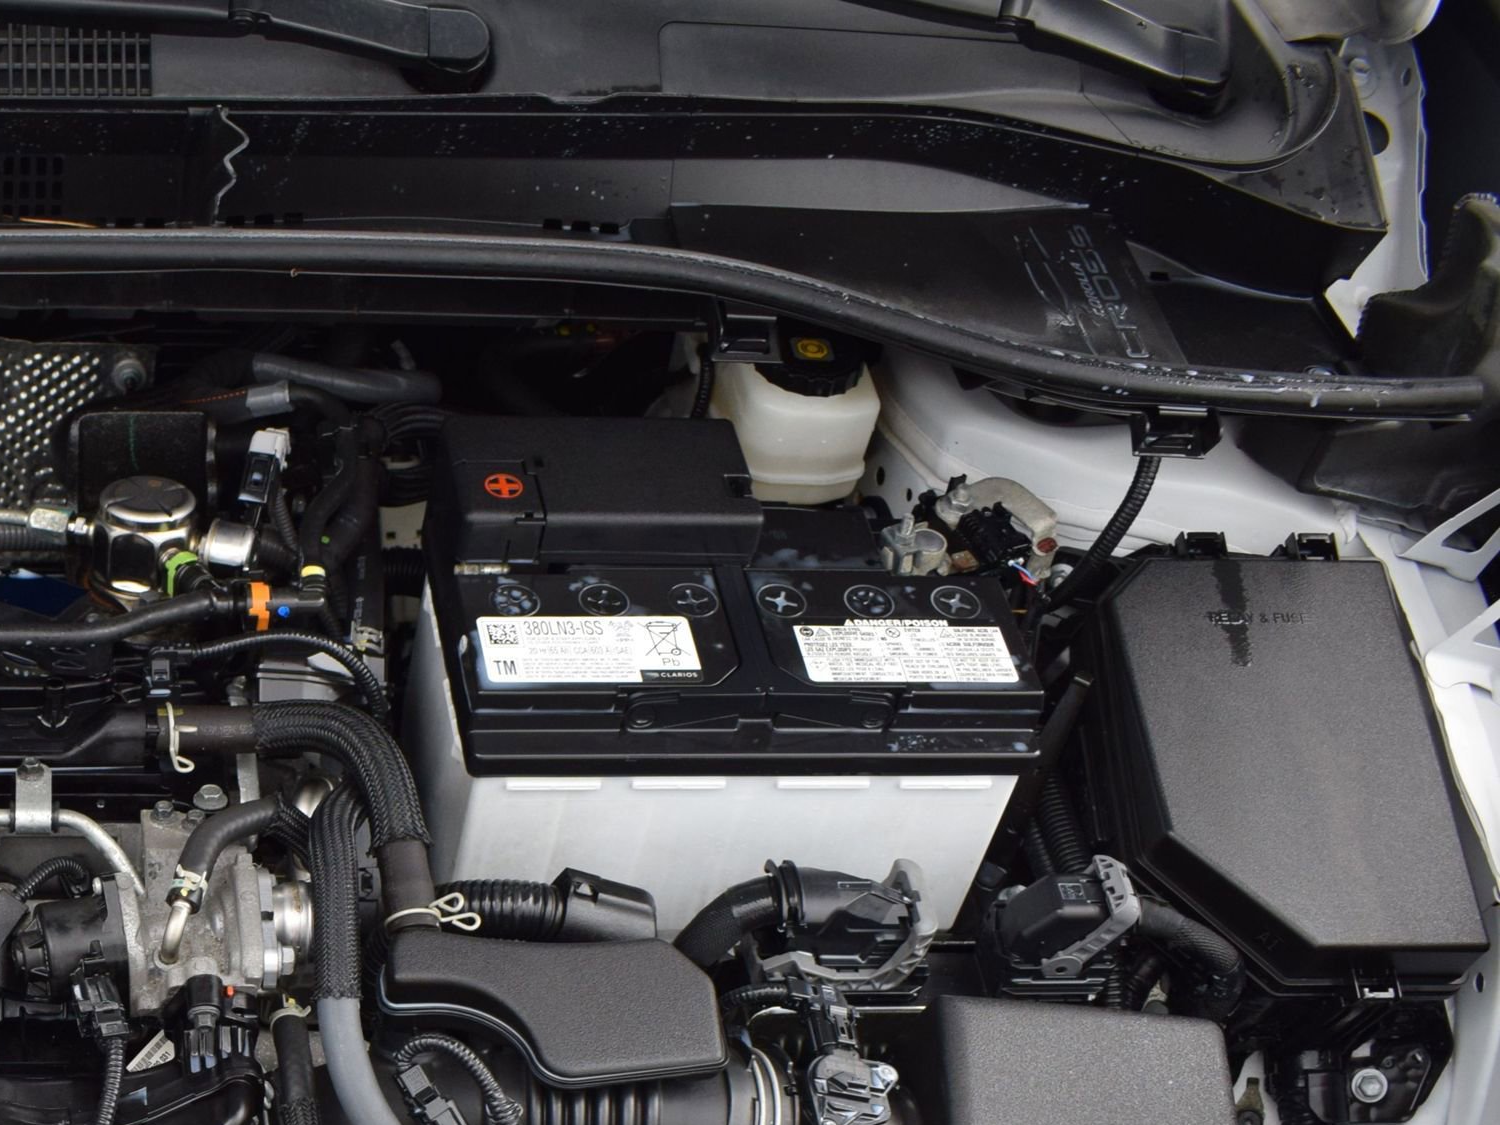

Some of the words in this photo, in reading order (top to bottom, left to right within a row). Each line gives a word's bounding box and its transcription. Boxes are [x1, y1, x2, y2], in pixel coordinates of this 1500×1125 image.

[1070, 262, 1107, 317] COROLLA
[523, 620, 604, 636] 380LN3-ISS
[493, 659, 518, 676] TM
[660, 671, 699, 679] CLARIOS
